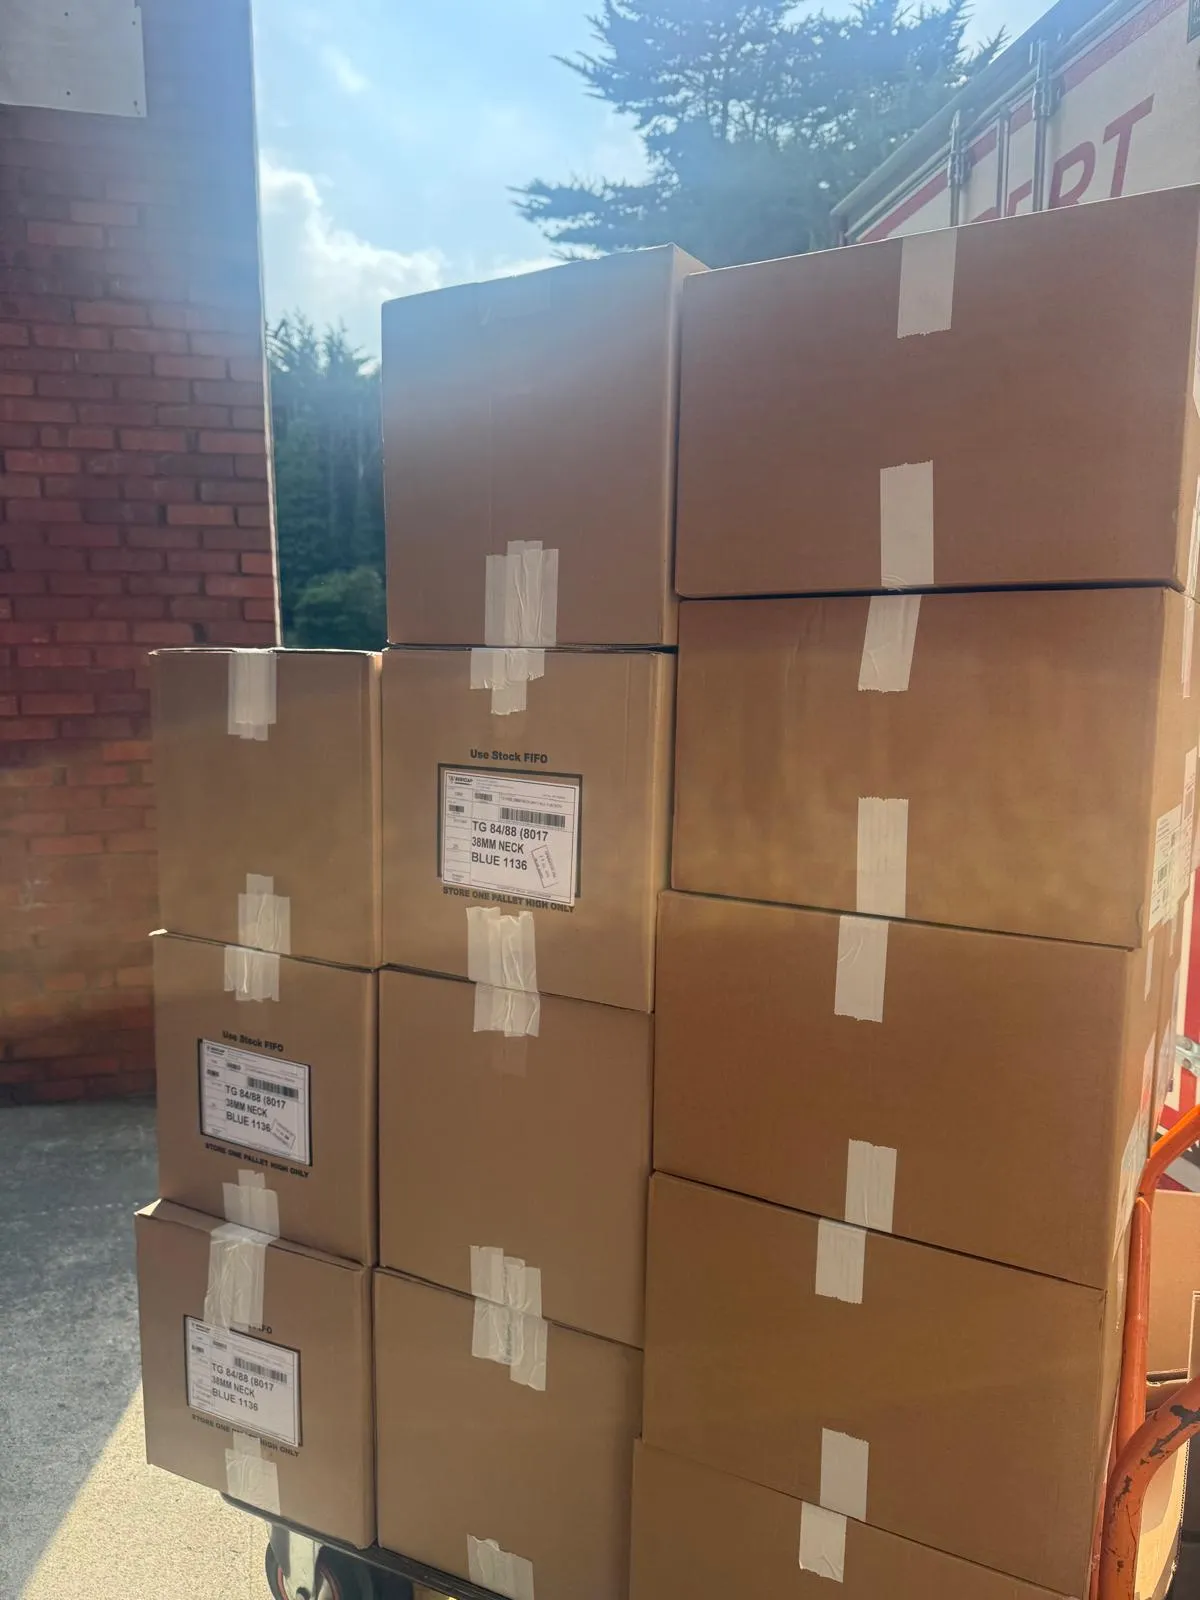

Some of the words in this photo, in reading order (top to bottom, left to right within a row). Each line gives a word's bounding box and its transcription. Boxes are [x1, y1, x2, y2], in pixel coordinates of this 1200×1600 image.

[470, 749, 489, 759] Use
[491, 751, 520, 762] Stock
[524, 753, 548, 763] FIFO
[472, 821, 486, 833] TG
[490, 824, 516, 837] 84/88
[520, 830, 548, 842] (8017
[472, 837, 496, 850] 38MM
[499, 839, 524, 854] NECK
[472, 852, 500, 866] BLUE
[504, 858, 527, 870] 1136
[443, 887, 470, 897] STORE
[472, 891, 490, 901] ONE
[492, 893, 524, 905] PALLET
[526, 897, 548, 909] HIGH
[551, 901, 574, 913] ONLY
[222, 1030, 237, 1041] Use
[240, 1035, 263, 1047] Stock
[264, 1040, 284, 1052] FIFO
[225, 1085, 237, 1096] TG
[240, 1088, 261, 1102] 84/88
[263, 1095, 286, 1109] (8017
[226, 1099, 246, 1111] 38MM
[247, 1104, 267, 1118] NECK
[227, 1111, 249, 1125] BLUE
[252, 1120, 271, 1132] 1136
[290, 1167, 309, 1178] ONLY
[212, 1363, 223, 1374] TG
[226, 1368, 249, 1383] 84/88
[250, 1377, 274, 1391] (8017
[212, 1388, 235, 1403] BLUE
[239, 1398, 258, 1411] 1136
[234, 1383, 255, 1397] NECK
